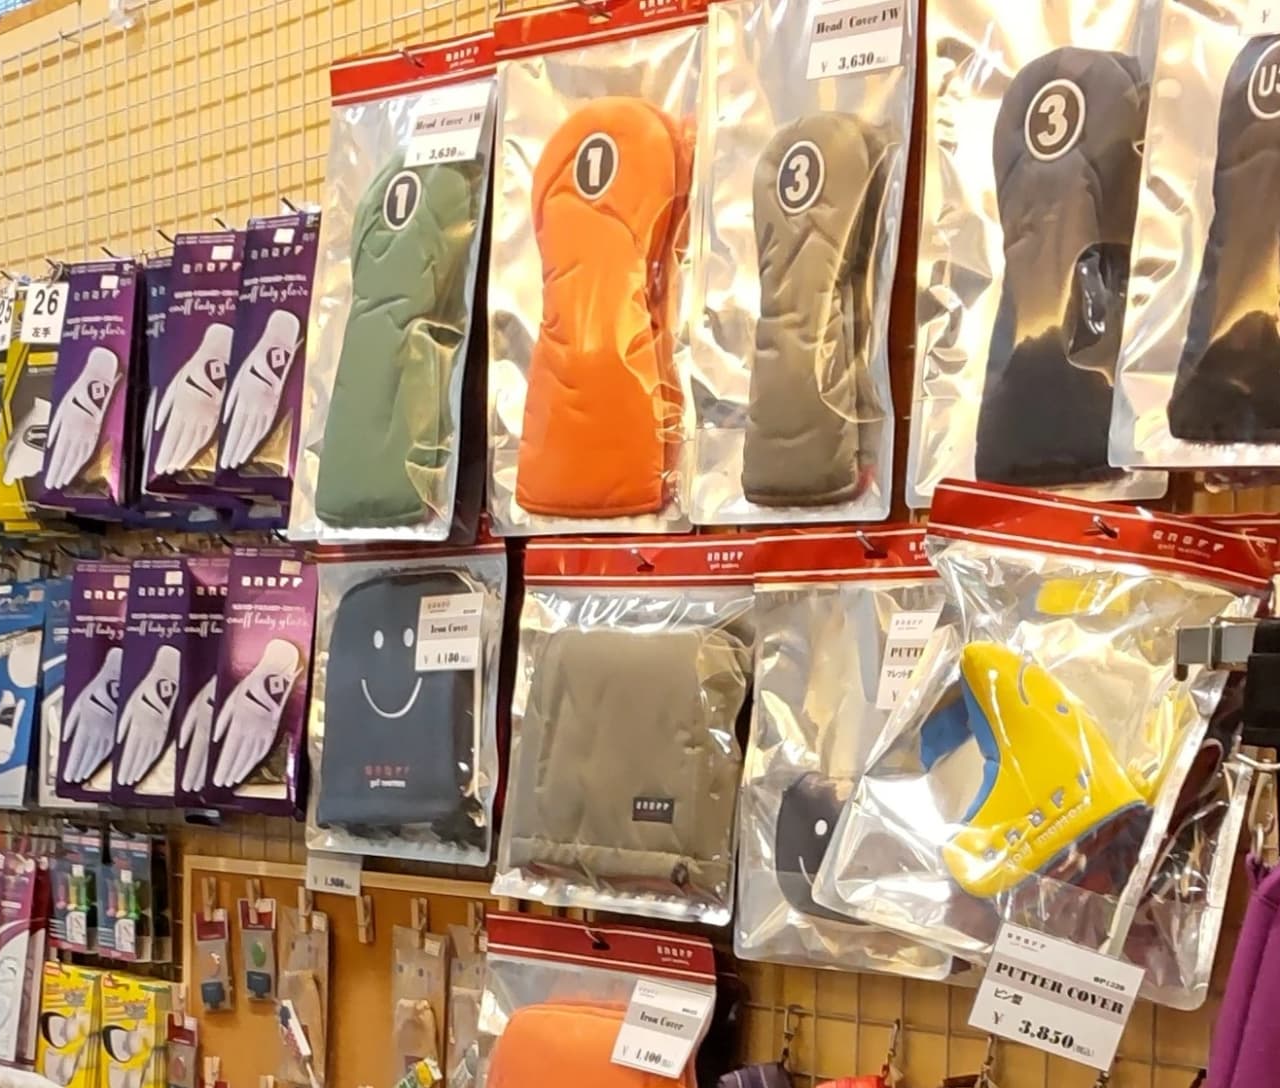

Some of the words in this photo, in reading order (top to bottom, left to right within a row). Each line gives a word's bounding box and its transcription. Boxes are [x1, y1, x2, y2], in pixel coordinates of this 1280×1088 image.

[815, 18, 843, 35] Head
[848, 13, 879, 30] Cover
[837, 51, 875, 71] 3,630
[1037, 94, 1068, 146] 3
[590, 148, 606, 186] 1
[787, 154, 810, 200] 3
[394, 183, 410, 219] 1
[32, 289, 61, 317] 26
[994, 961, 1064, 995] PUTTER
[1066, 986, 1125, 1015] COVER
[639, 1010, 659, 1025] Iron
[660, 1017, 685, 1032] Cover
[1018, 1019, 1075, 1050] 3,850
